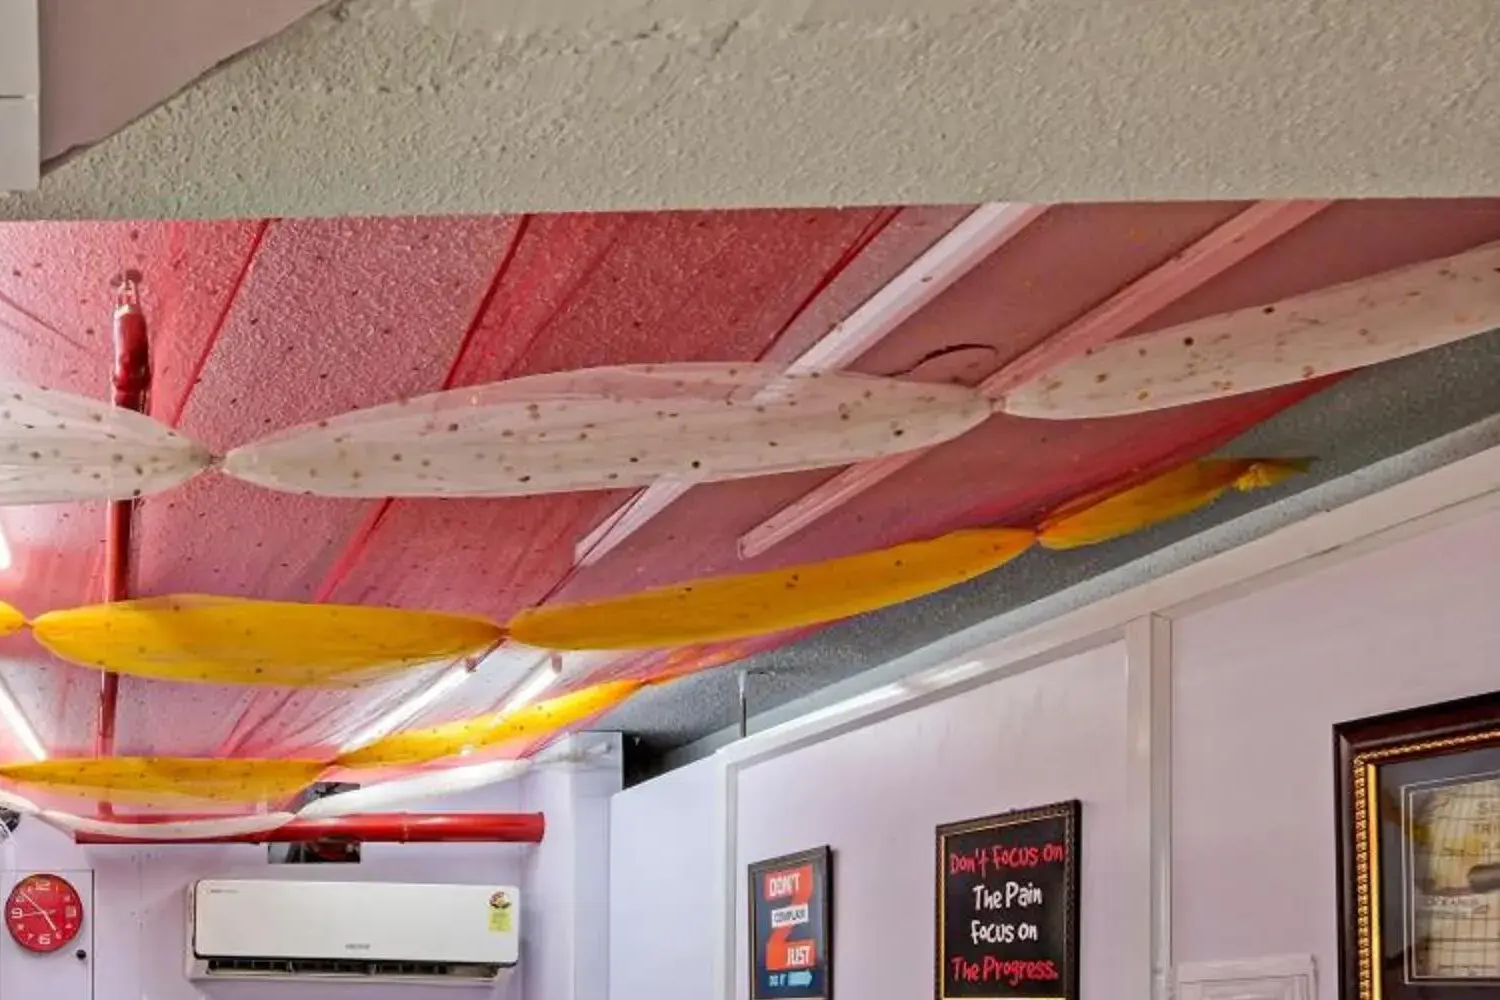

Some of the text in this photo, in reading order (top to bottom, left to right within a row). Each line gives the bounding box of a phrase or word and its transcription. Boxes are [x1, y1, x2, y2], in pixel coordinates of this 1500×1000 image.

[950, 843, 1063, 877] Don't Focus on
[973, 881, 1042, 910] The Pain
[971, 920, 1038, 945] Focus on
[951, 956, 1059, 986] The Progress.
